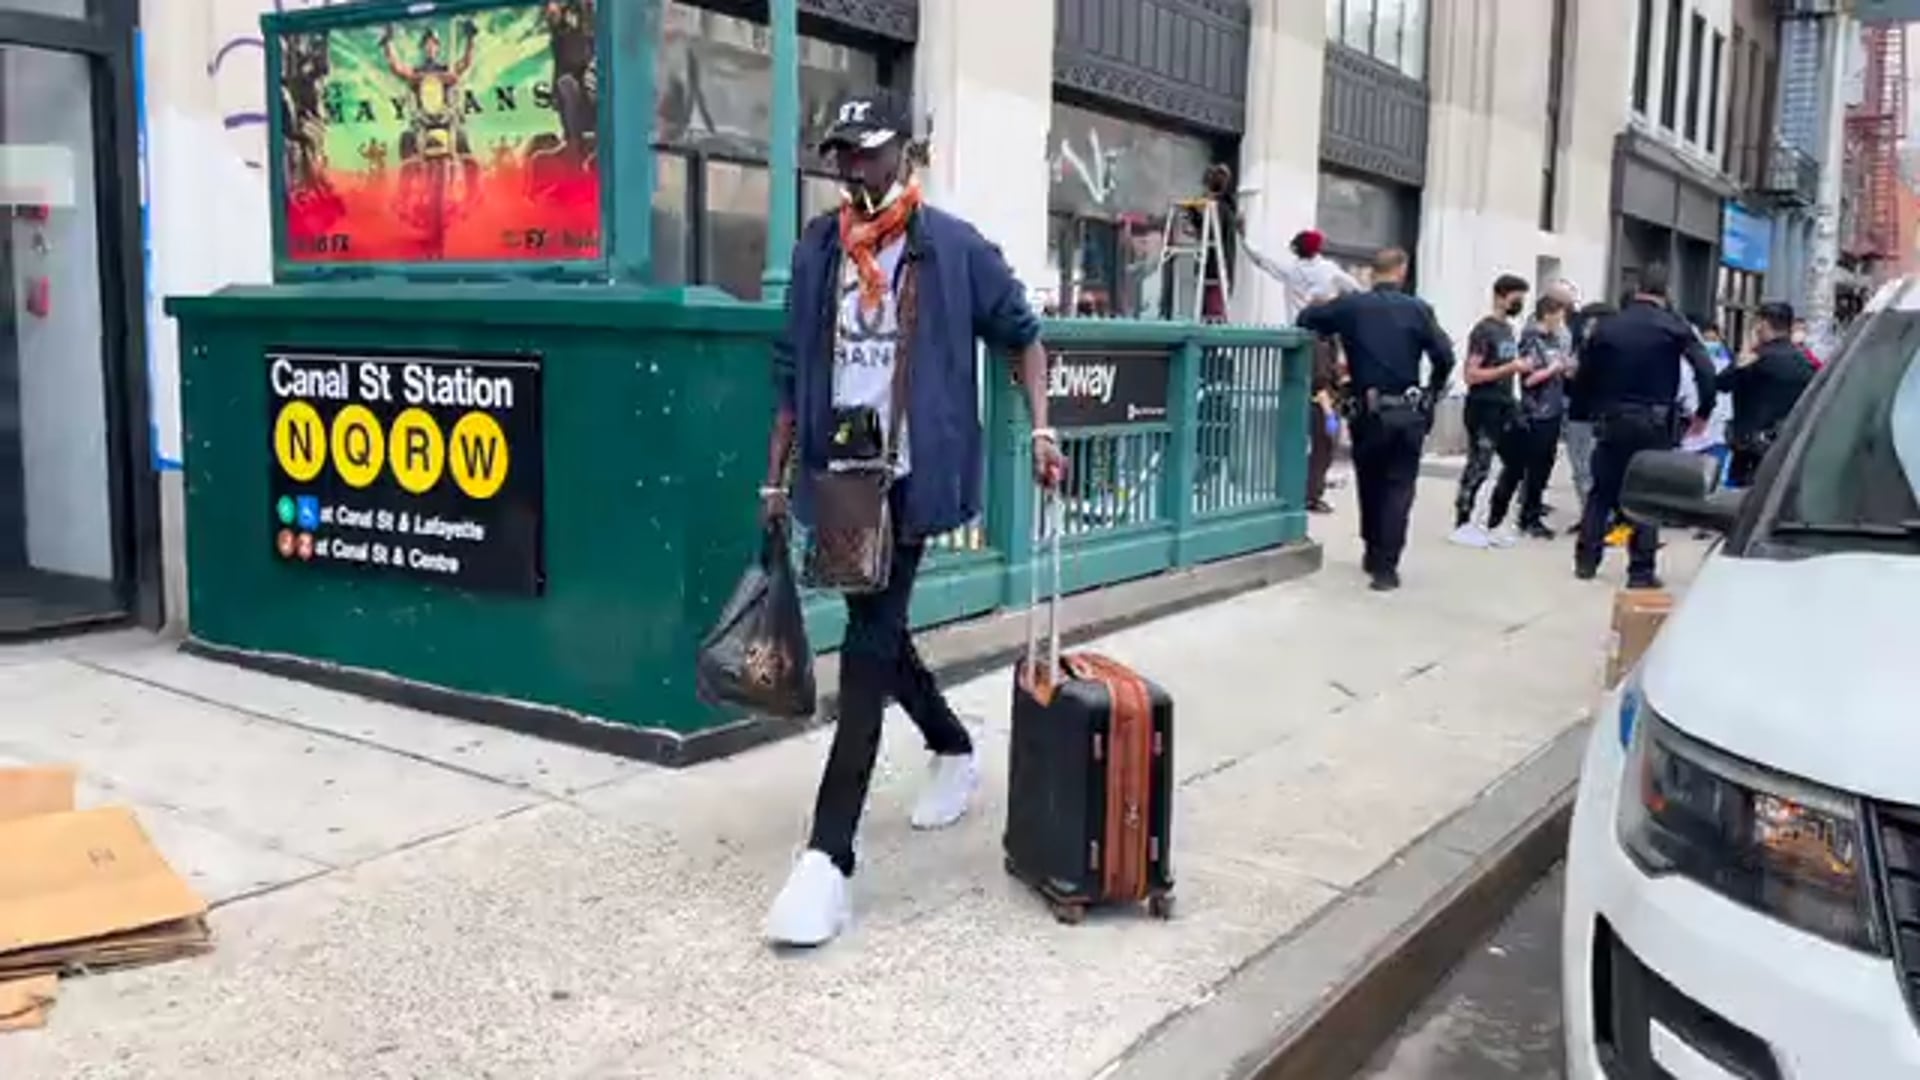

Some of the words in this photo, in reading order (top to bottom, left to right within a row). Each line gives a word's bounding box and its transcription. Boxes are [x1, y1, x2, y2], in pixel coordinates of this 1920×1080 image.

[323, 81, 555, 125] MAYANS
[270, 357, 349, 399] Canal
[358, 361, 393, 401] St
[402, 363, 513, 408] Station
[288, 419, 313, 463] N
[344, 422, 371, 468] Q
[405, 425, 430, 472] R
[460, 434, 497, 481] W
[319, 505, 334, 524] at
[336, 504, 373, 529] Canal
[377, 508, 395, 532] St
[398, 511, 410, 533] &
[413, 513, 485, 541] Lafayette
[314, 538, 329, 557] at
[331, 537, 369, 562] Canal
[371, 541, 388, 565] St
[392, 545, 405, 567] &
[407, 547, 460, 574] Centre
